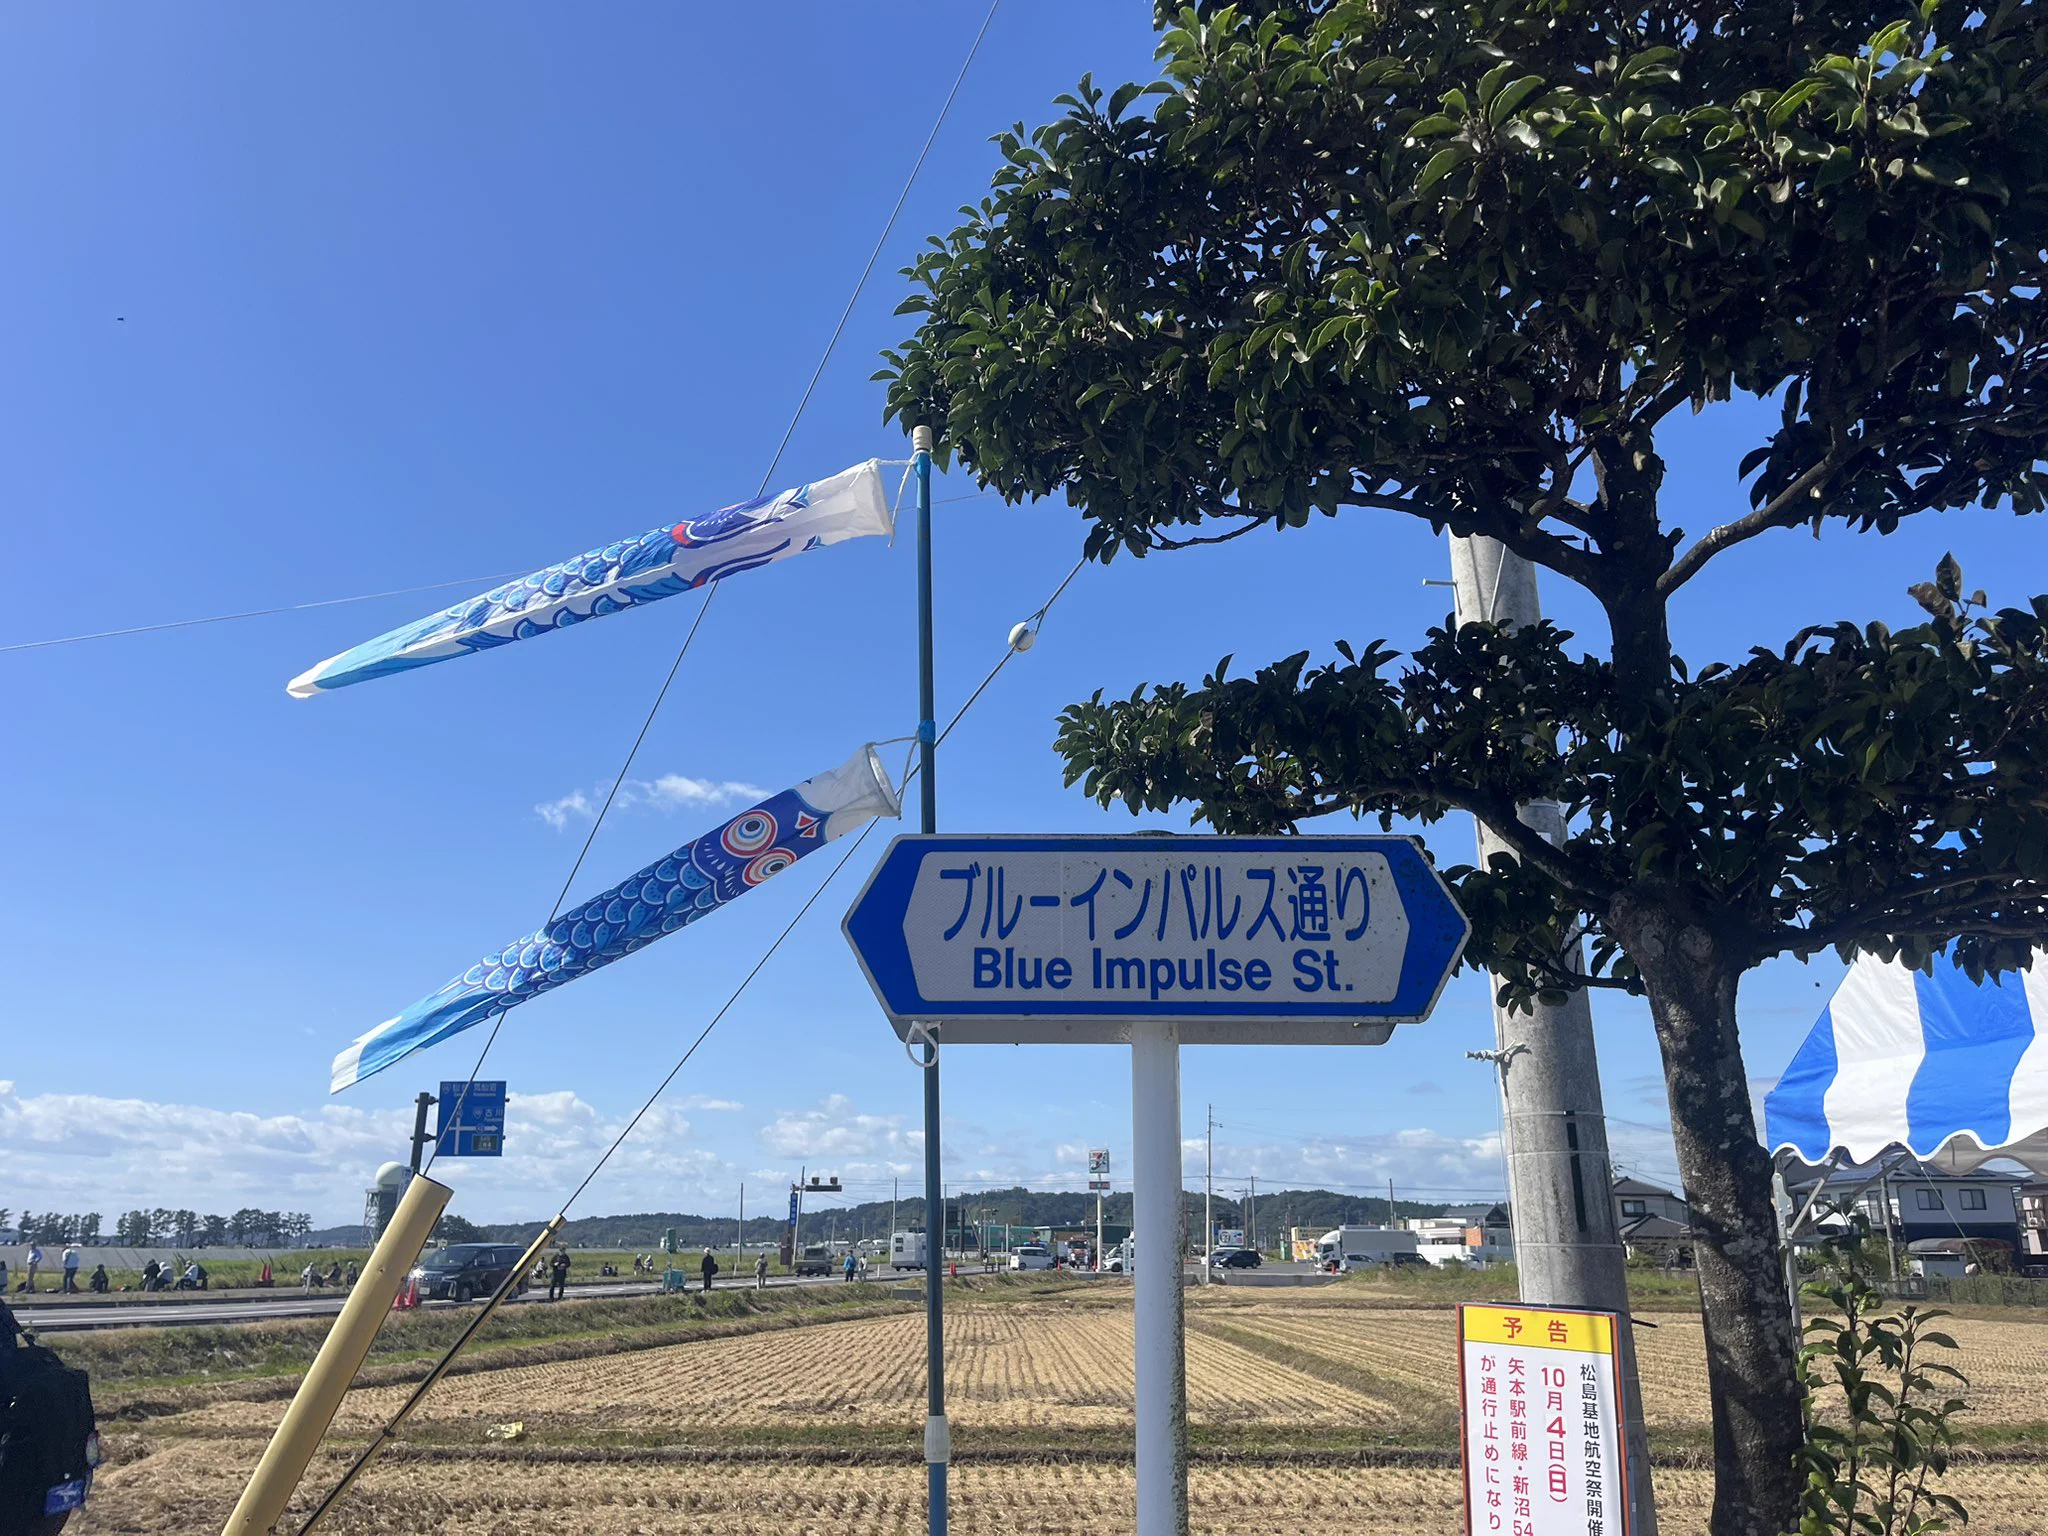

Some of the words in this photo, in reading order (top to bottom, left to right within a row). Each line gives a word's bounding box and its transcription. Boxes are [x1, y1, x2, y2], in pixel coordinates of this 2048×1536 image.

[940, 862, 1371, 942] ブルーインパルス通り
[973, 947, 1073, 990] Blue
[1093, 947, 1272, 1000] Impulse
[1292, 949, 1355, 992] St.
[1481, 1355, 1502, 1530] が通行止めになり
[1580, 1363, 1604, 1536] 松島基地航空祭開催
